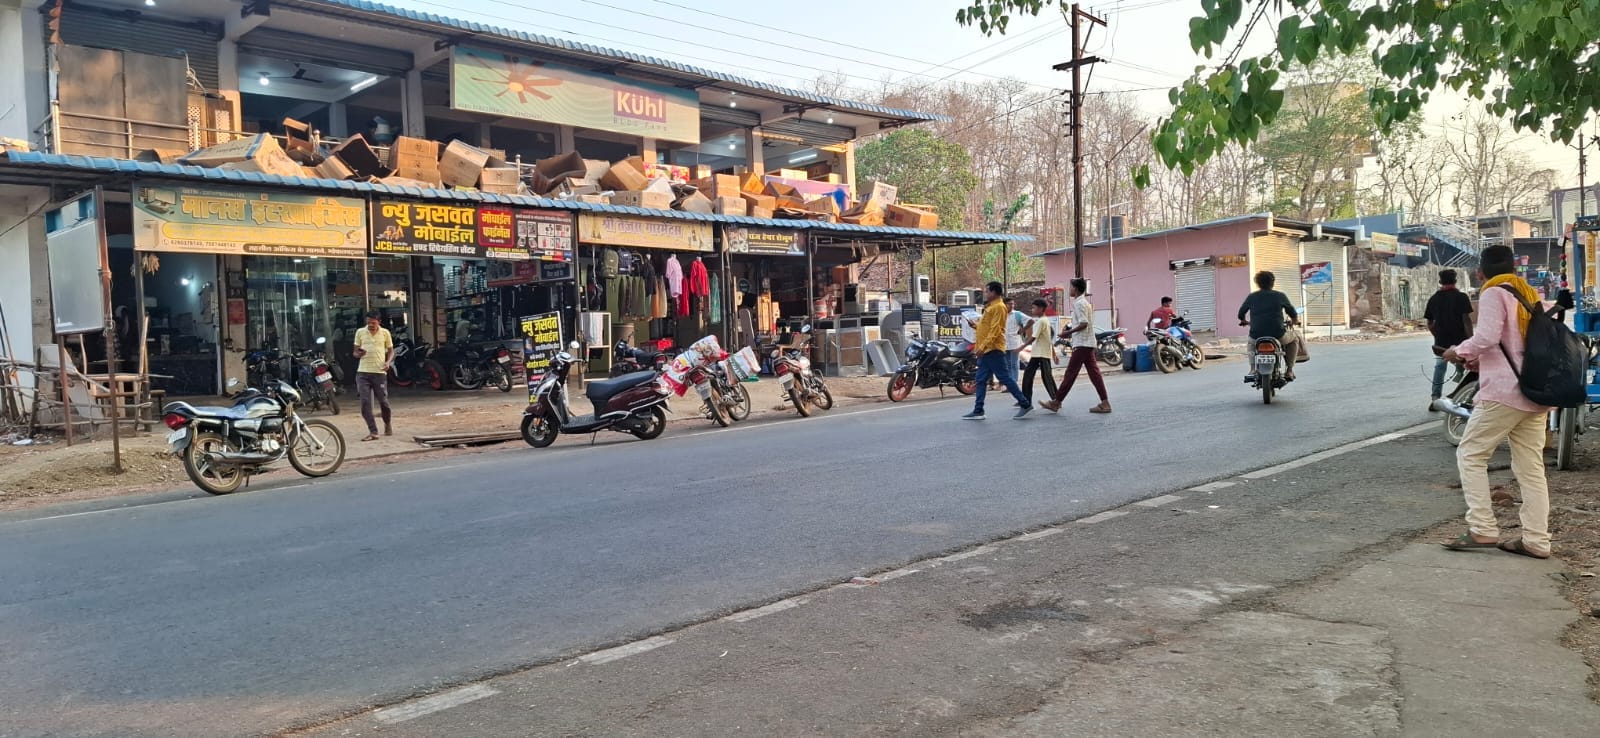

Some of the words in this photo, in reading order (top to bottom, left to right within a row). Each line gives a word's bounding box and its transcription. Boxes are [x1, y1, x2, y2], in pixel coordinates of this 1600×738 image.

[618, 91, 663, 119] Kühl
[181, 195, 246, 220] मानस
[481, 211, 511, 225] मोबाईल
[414, 223, 475, 243] मोबाईल
[375, 241, 393, 251] JCB
